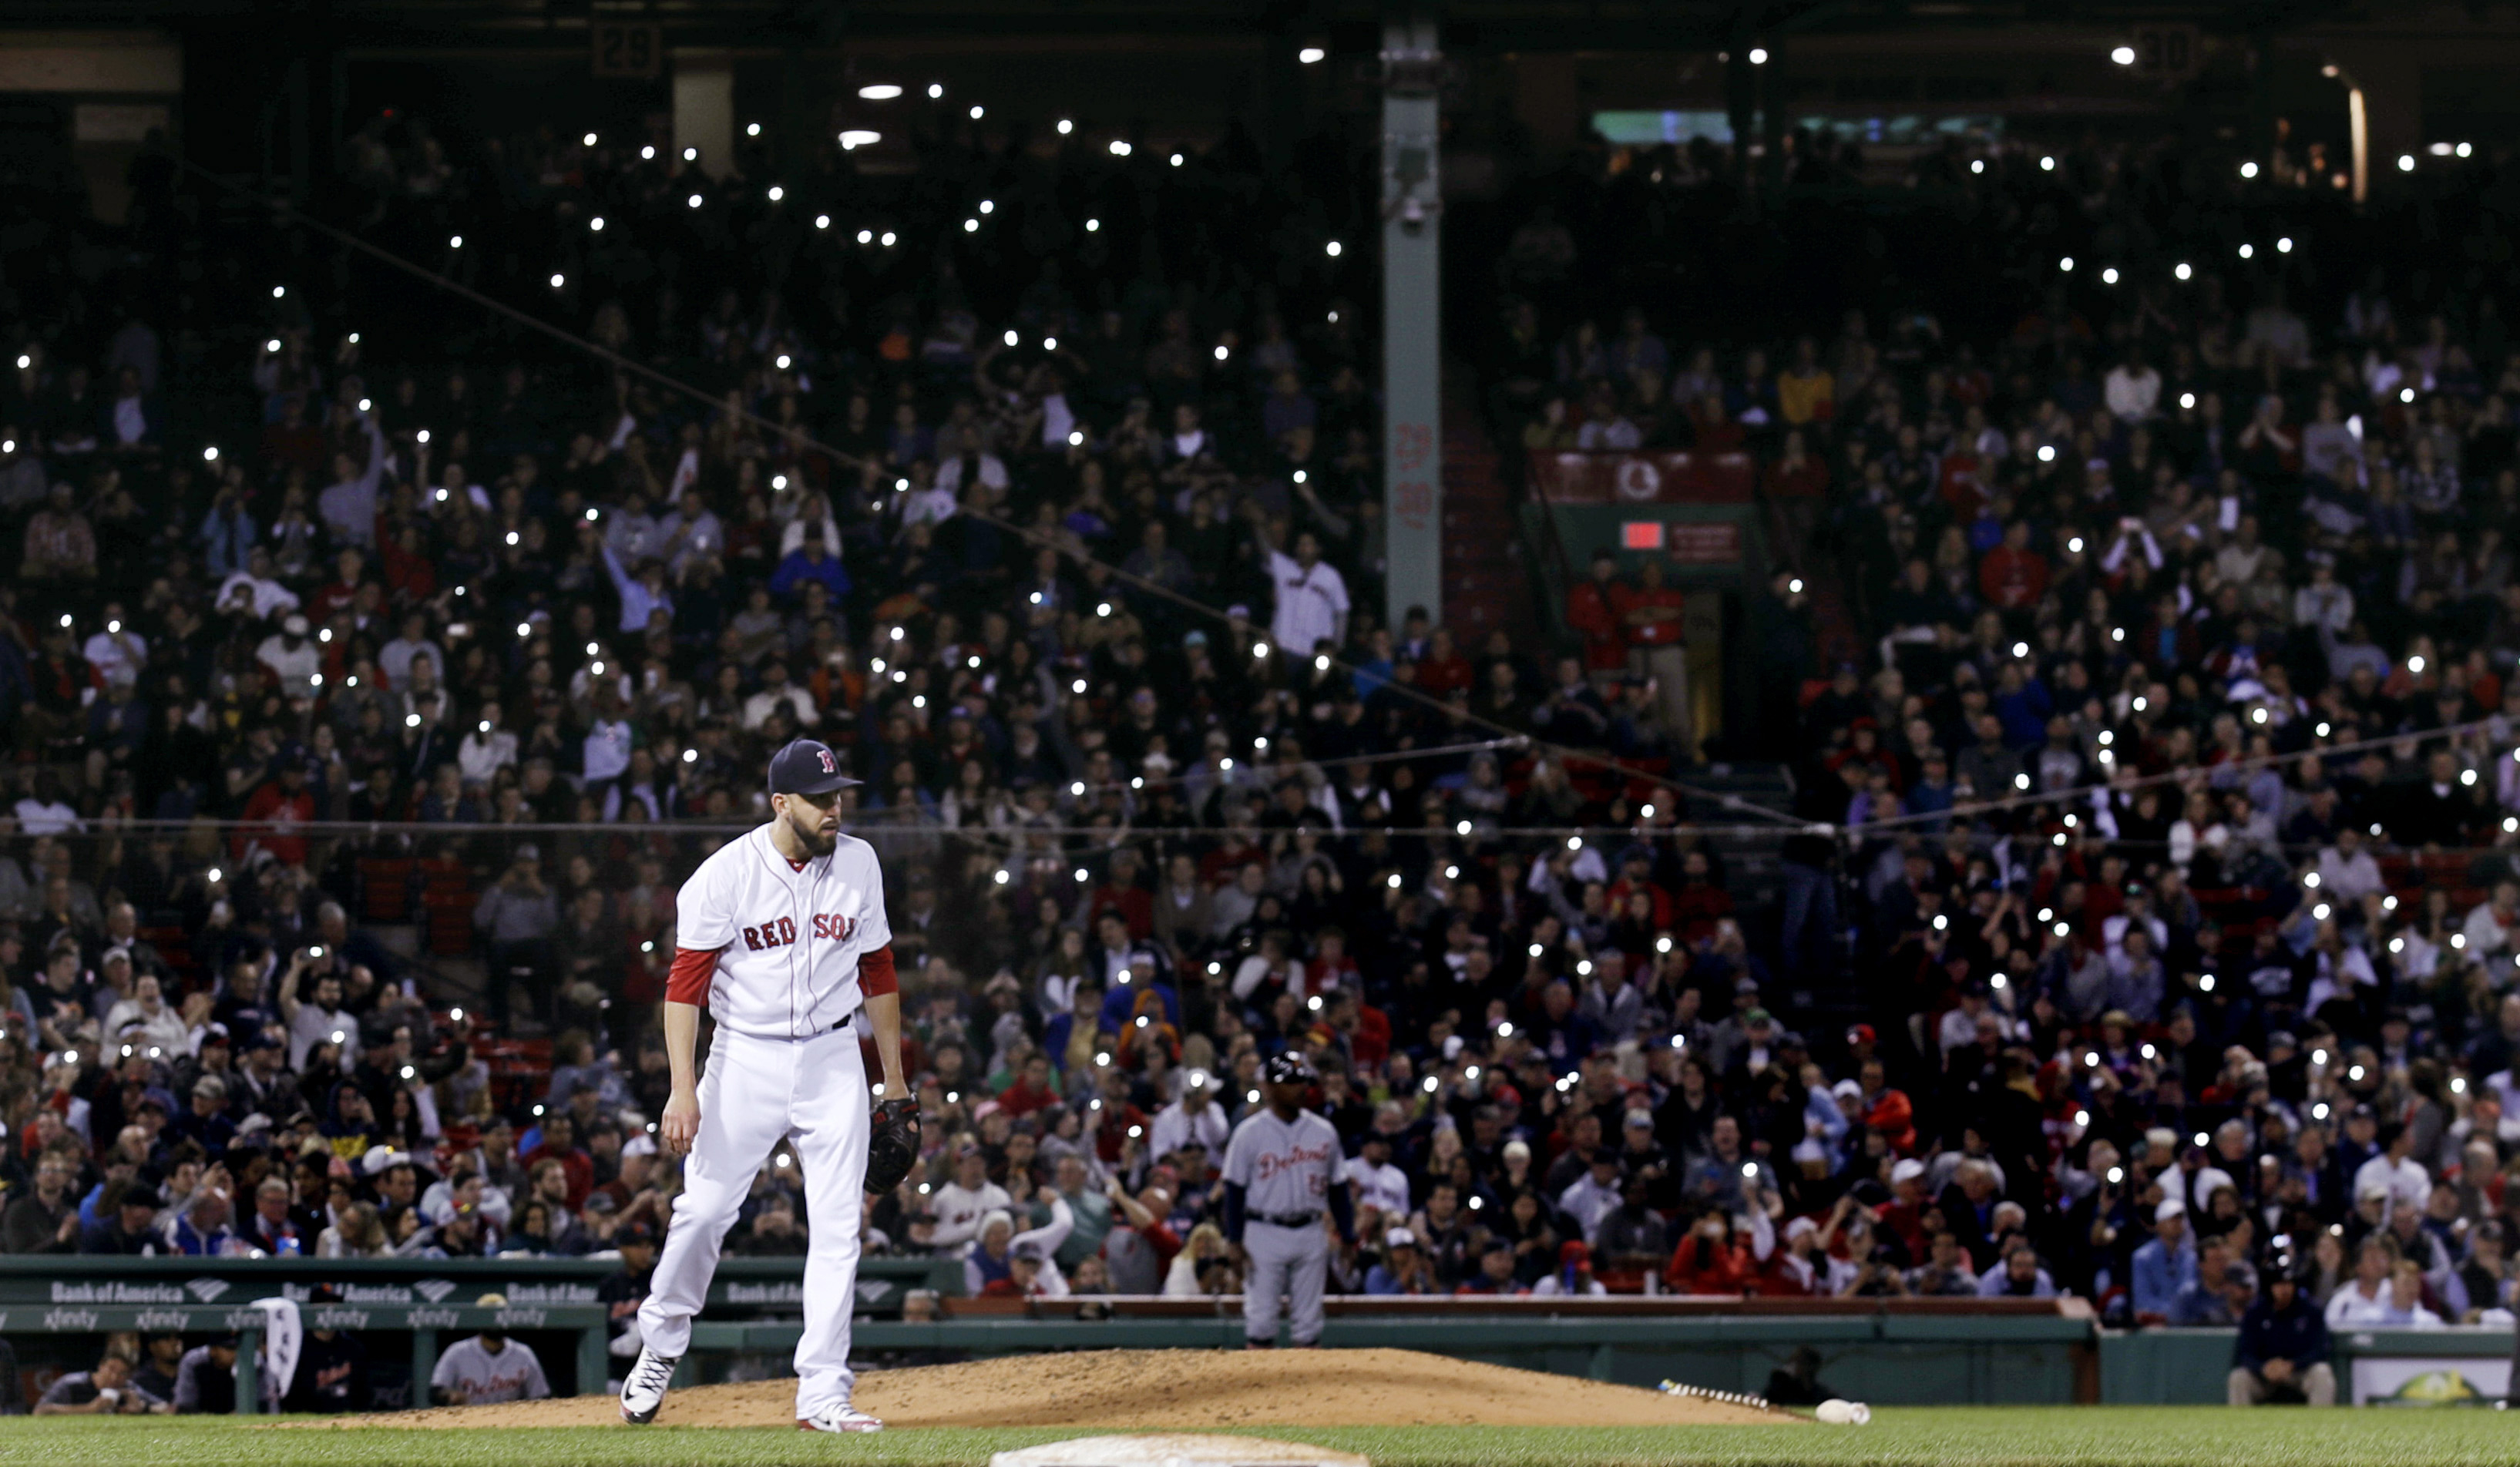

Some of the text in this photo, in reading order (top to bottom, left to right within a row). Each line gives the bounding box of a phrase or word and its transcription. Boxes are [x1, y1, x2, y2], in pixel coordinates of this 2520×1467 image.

[603, 27, 651, 69] 29
[743, 916, 796, 952] RED
[51, 1281, 185, 1302] Bank of America
[506, 1281, 546, 1301] Bank
[44, 1307, 99, 1331] xfinity
[135, 1307, 190, 1331] xfinity
[315, 1306, 369, 1331] xfinity
[406, 1306, 460, 1331] xfinity
[494, 1306, 548, 1331] xfinity
